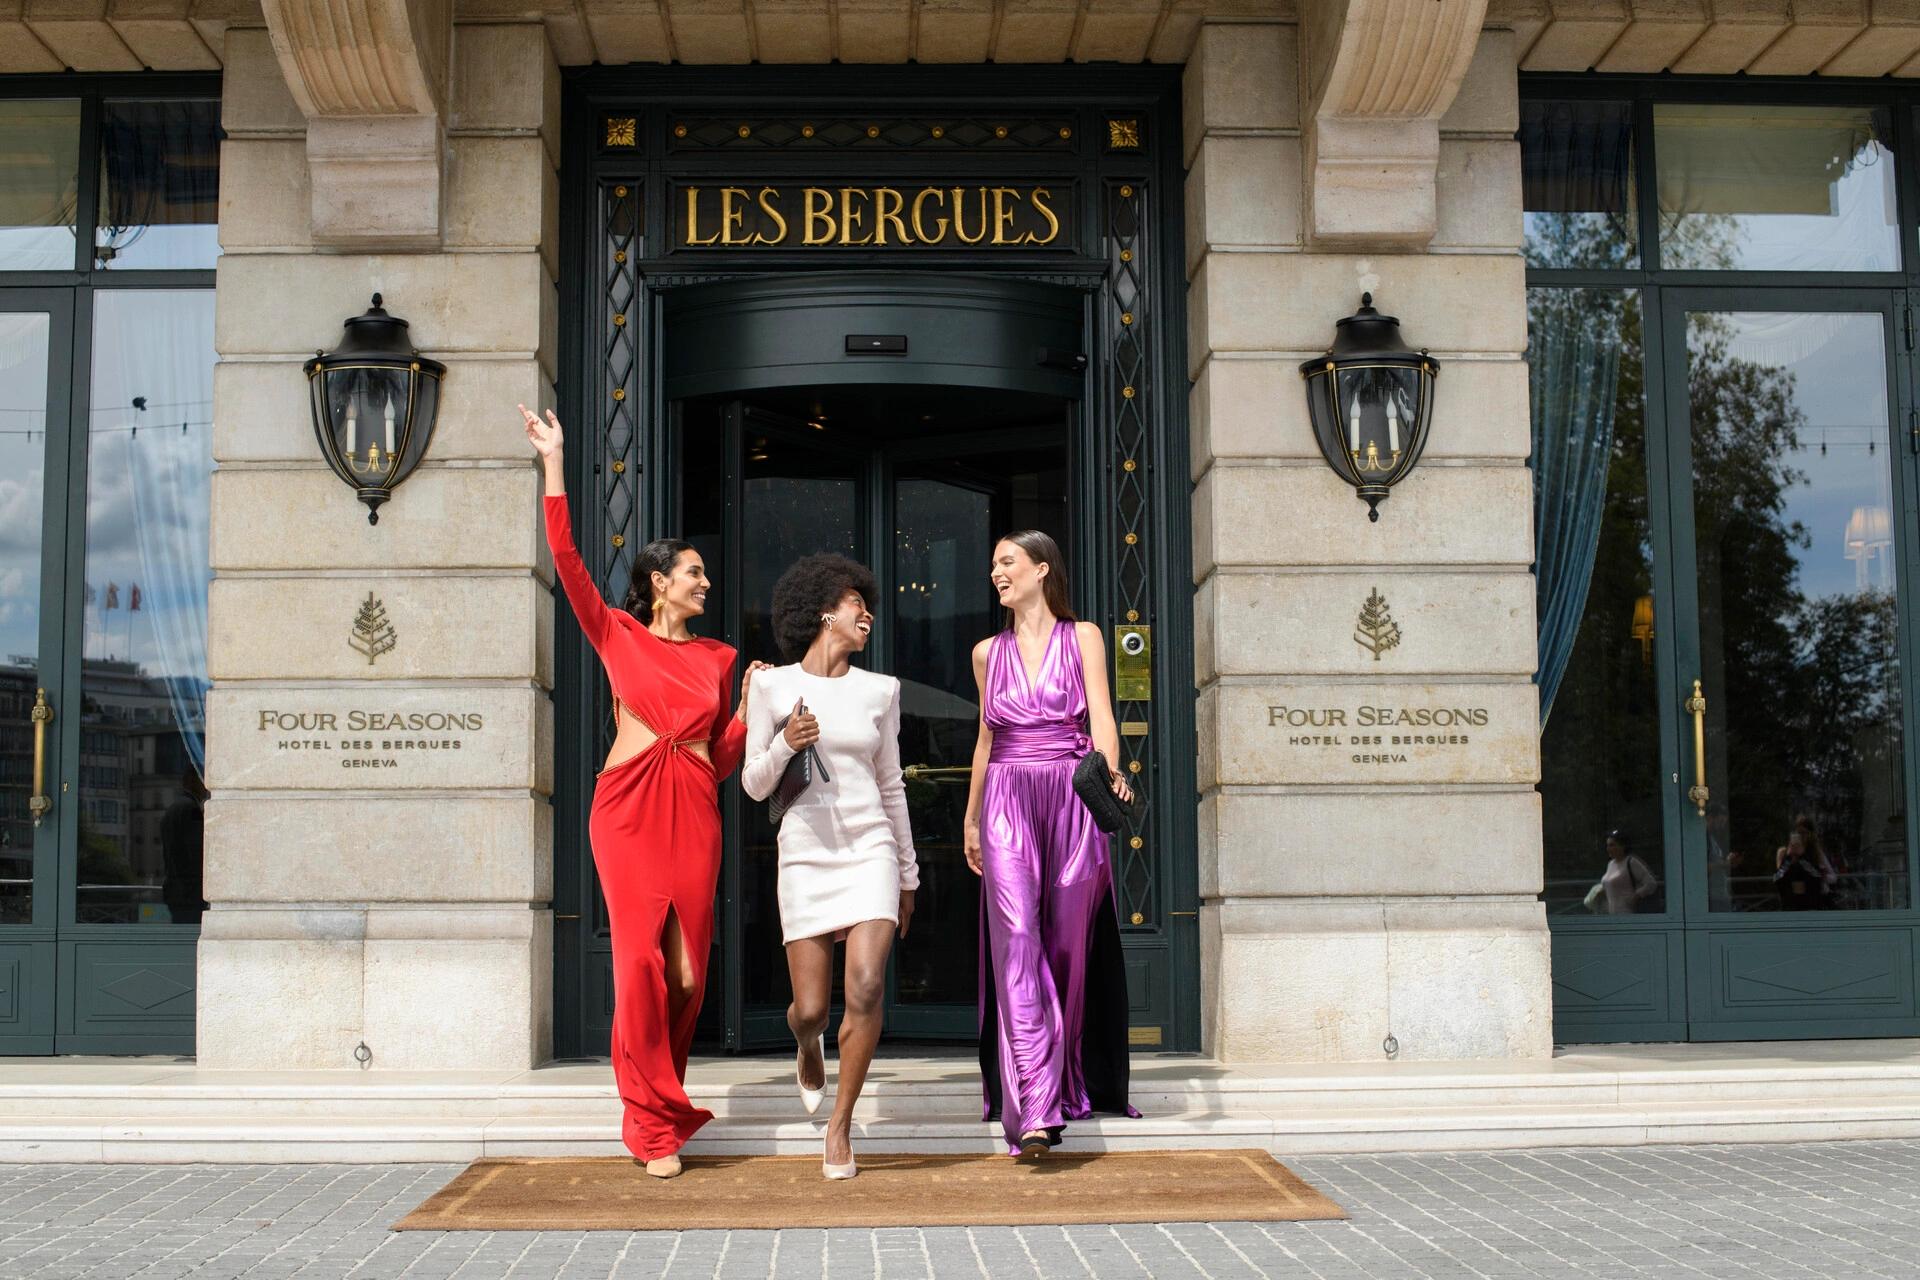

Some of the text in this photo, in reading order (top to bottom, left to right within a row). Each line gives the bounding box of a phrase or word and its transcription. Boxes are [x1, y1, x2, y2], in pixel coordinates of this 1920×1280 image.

[685, 186, 1060, 246] LES BERGUES
[258, 710, 483, 731] FOUR SEASONS
[1268, 705, 1489, 727] FOUR SEASONS
[278, 740, 462, 750] HOTEL DES BERGUES
[1289, 735, 1470, 746] HOTEL DES BERGUES
[341, 759, 398, 768] GENEVA
[1351, 754, 1408, 764] GENEVA
